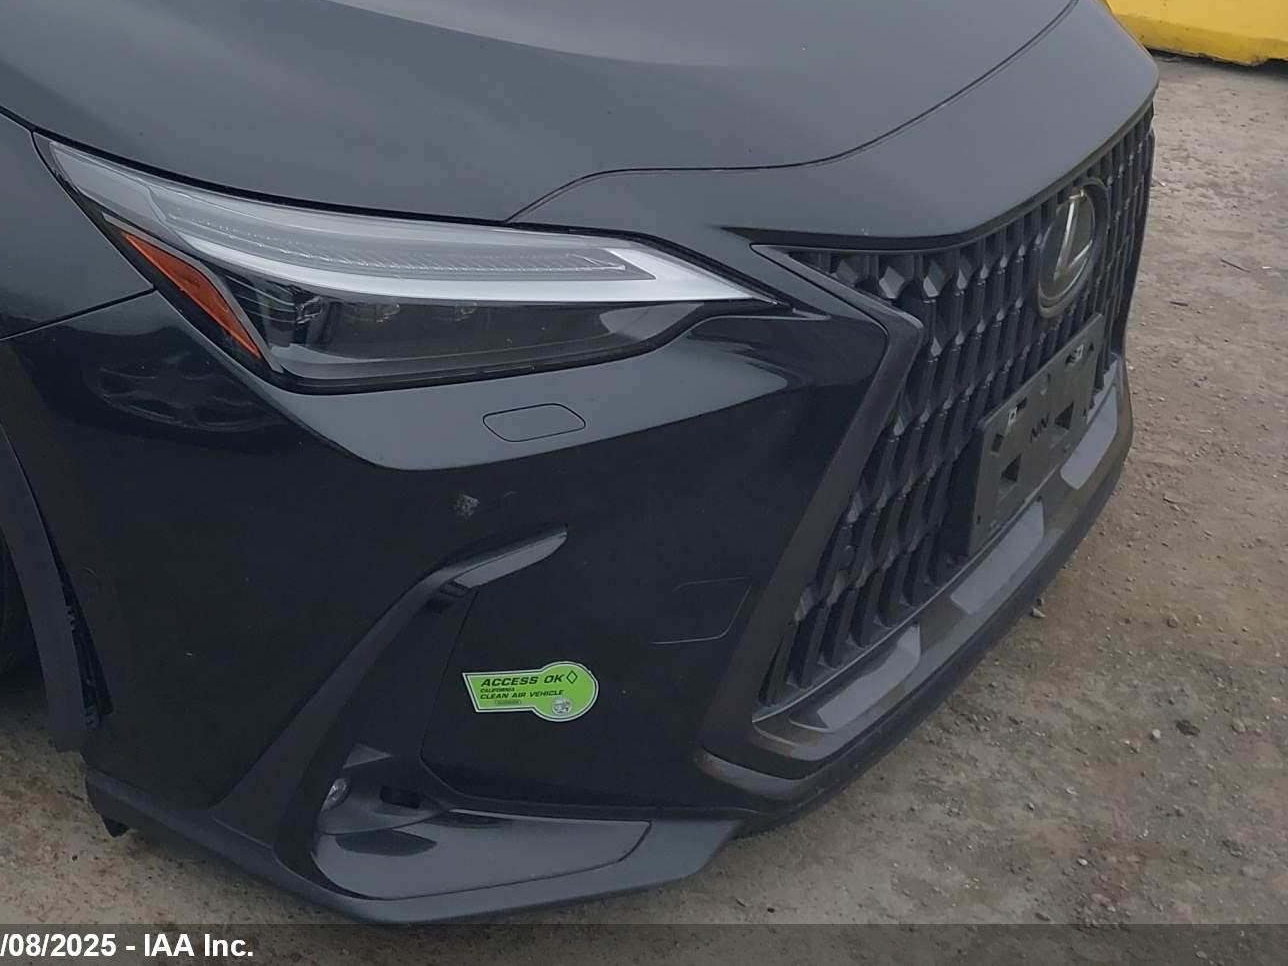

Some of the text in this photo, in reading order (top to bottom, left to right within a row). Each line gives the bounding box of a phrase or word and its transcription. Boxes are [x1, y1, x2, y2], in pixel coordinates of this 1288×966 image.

[480, 674, 565, 687] ACCESS OK
[529, 689, 564, 697] VEHICLE
